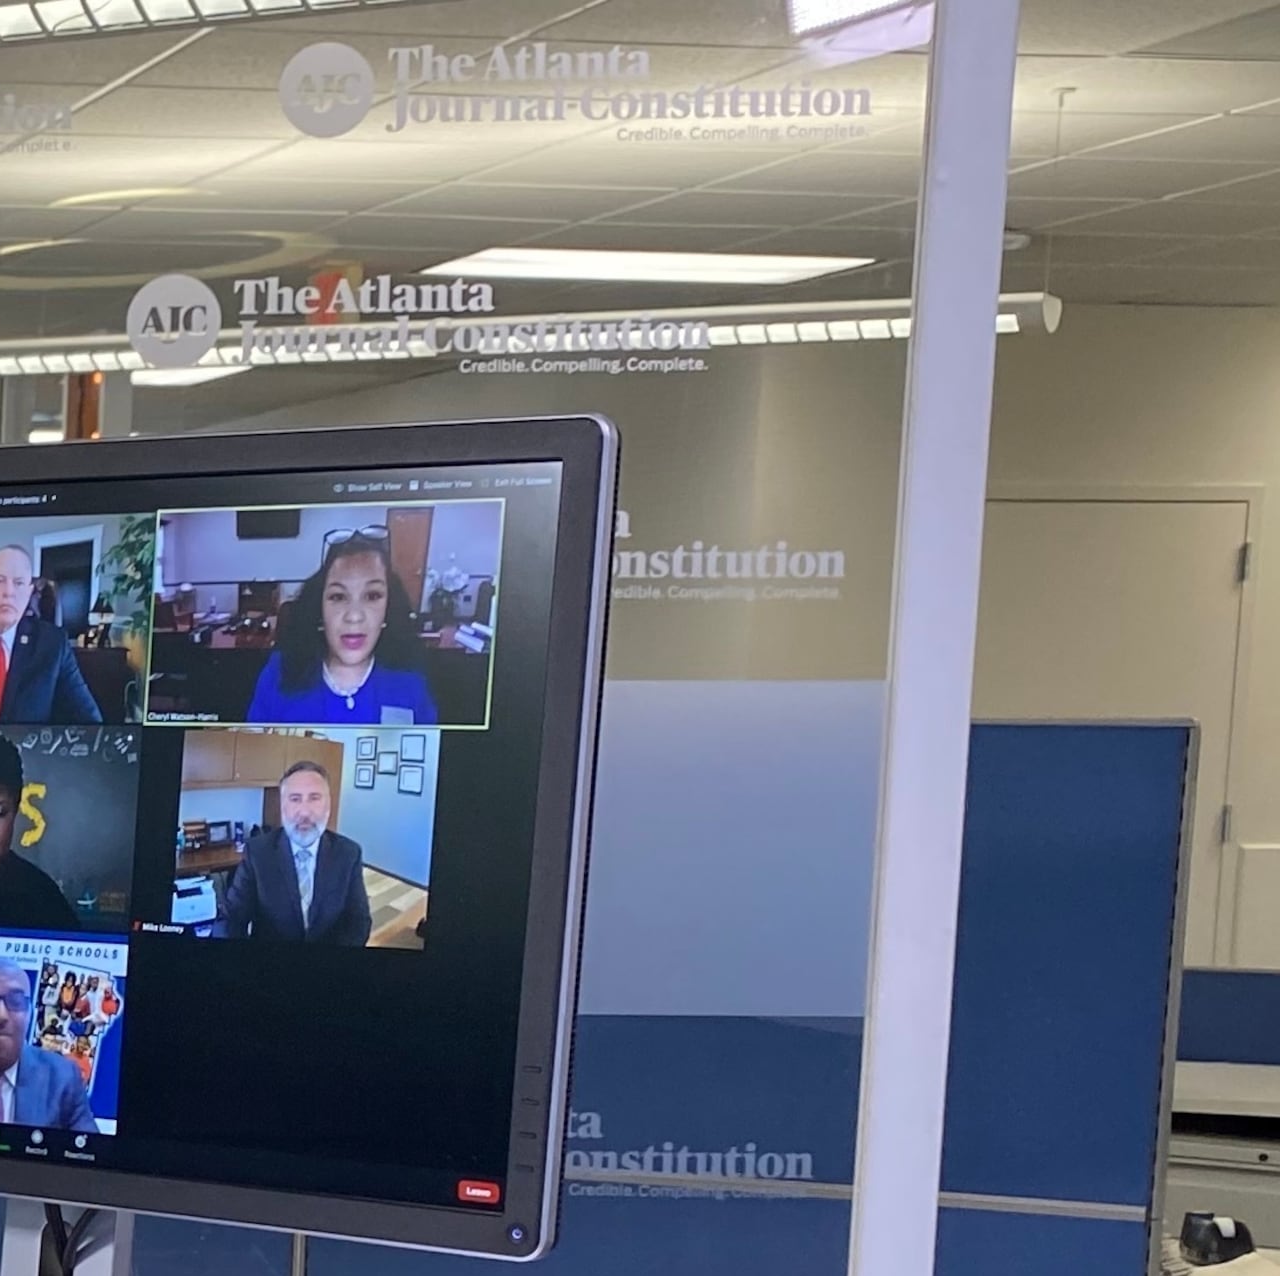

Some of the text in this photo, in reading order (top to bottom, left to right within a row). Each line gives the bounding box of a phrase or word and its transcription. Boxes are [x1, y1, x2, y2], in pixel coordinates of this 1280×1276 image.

[389, 41, 650, 82] The Atlanta
[386, 80, 872, 133] Journal-Constitution
[233, 273, 495, 315] The Atlanta
[140, 305, 207, 343] AJC
[231, 313, 712, 365] Journal-Constitution
[459, 356, 709, 377] Credible. Compelling. Complete.
[613, 540, 846, 579] nstitution
[6, 942, 52, 956] PUBLIC
[58, 945, 119, 960] SCHOOLS
